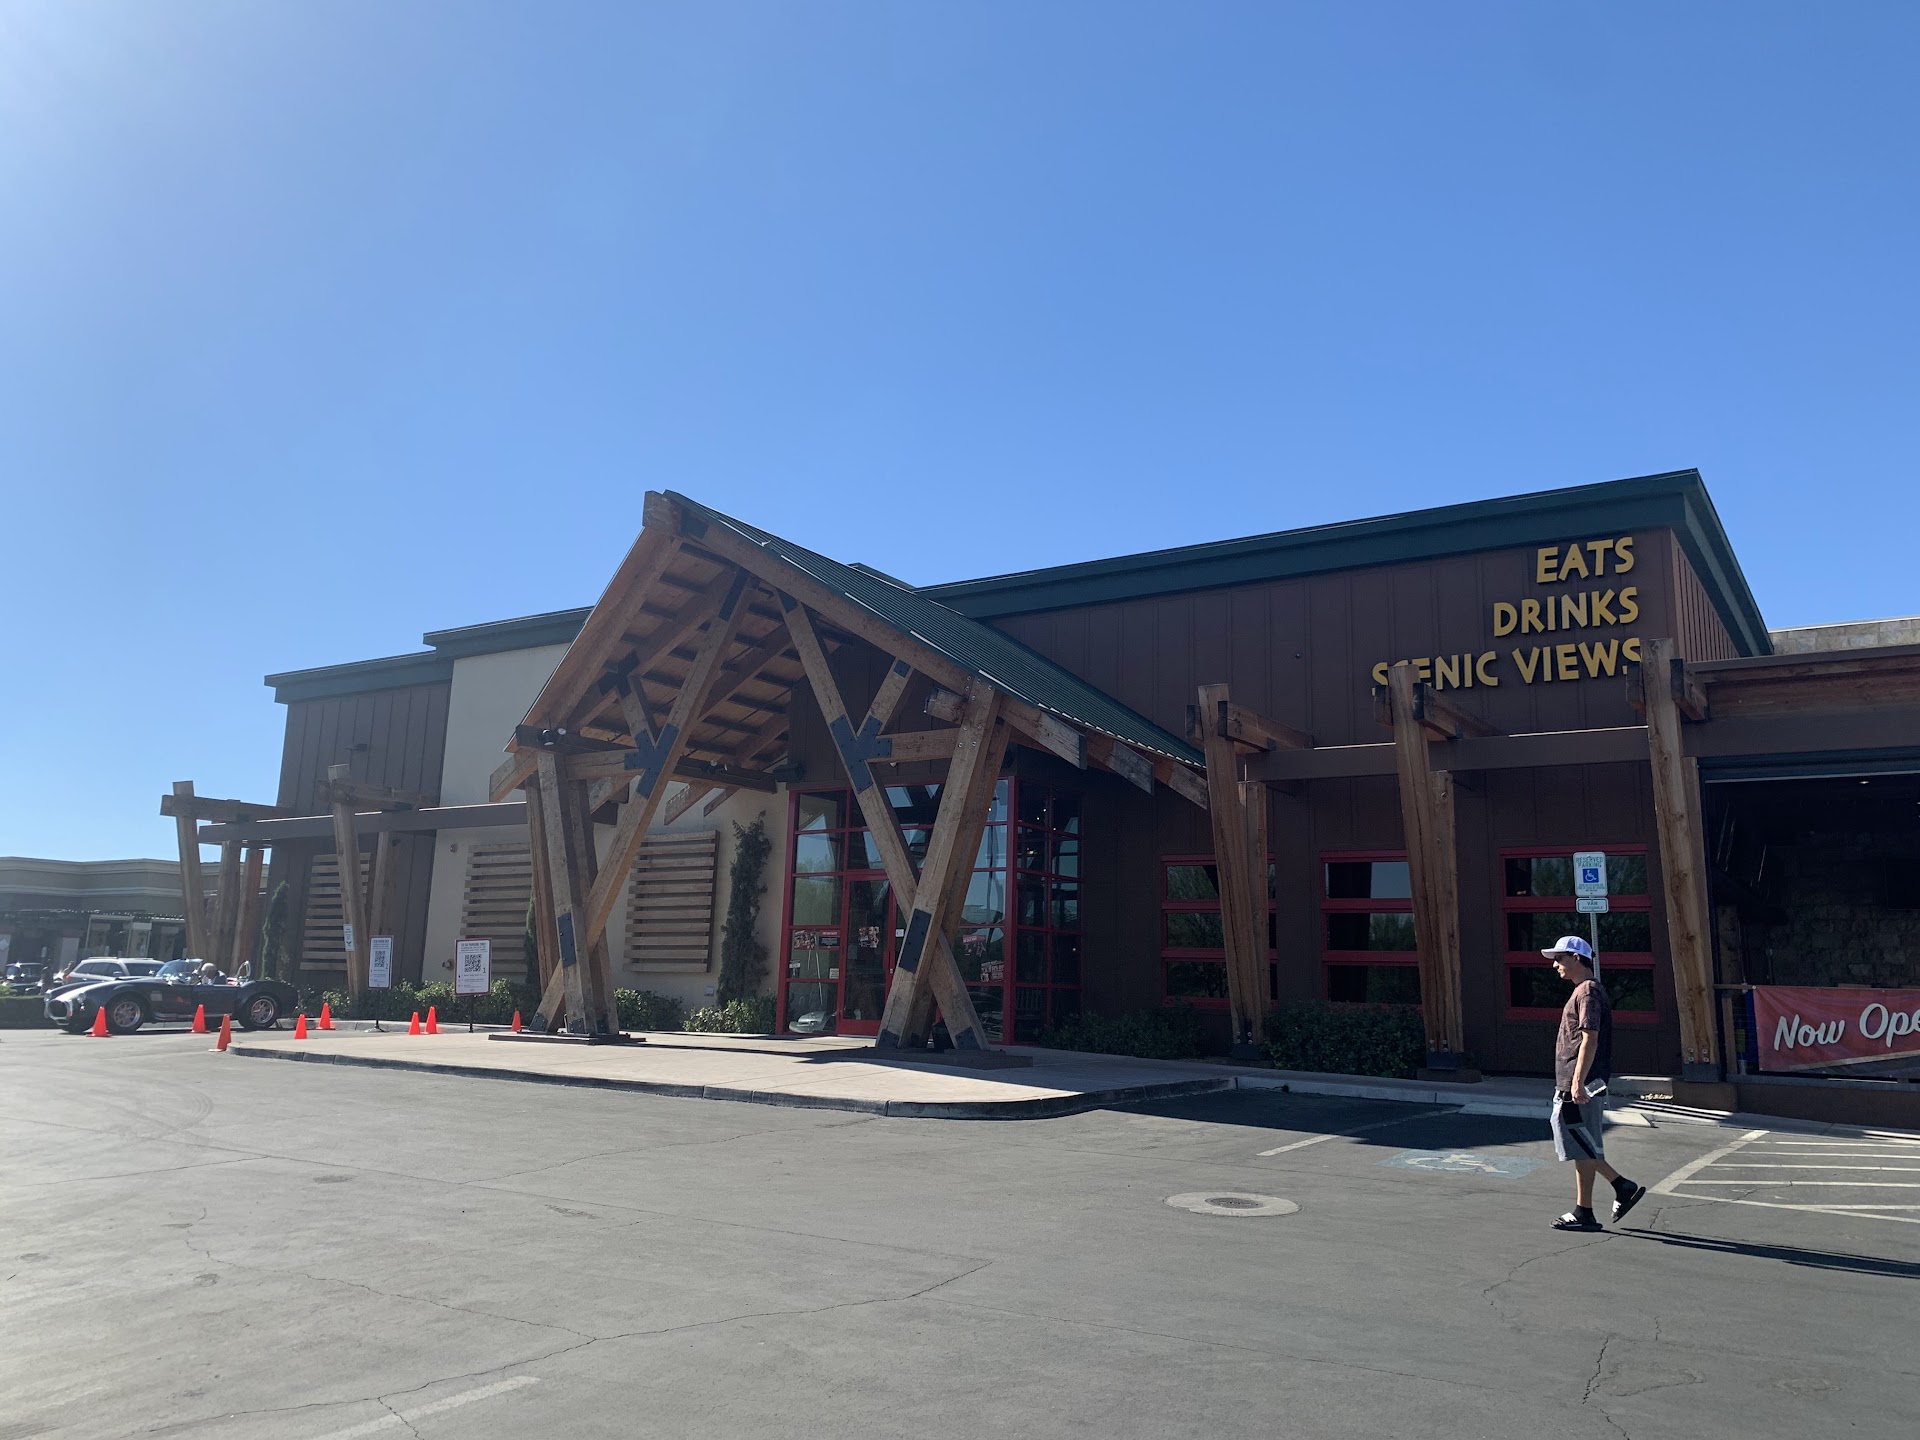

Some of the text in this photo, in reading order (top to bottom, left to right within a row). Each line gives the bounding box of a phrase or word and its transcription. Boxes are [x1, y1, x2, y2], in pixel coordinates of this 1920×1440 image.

[1536, 537, 1635, 583] EATS
[1493, 586, 1639, 637] DRINKS
[1371, 637, 1641, 697] SENIC VIEWS
[1774, 1014, 1846, 1051] Now
